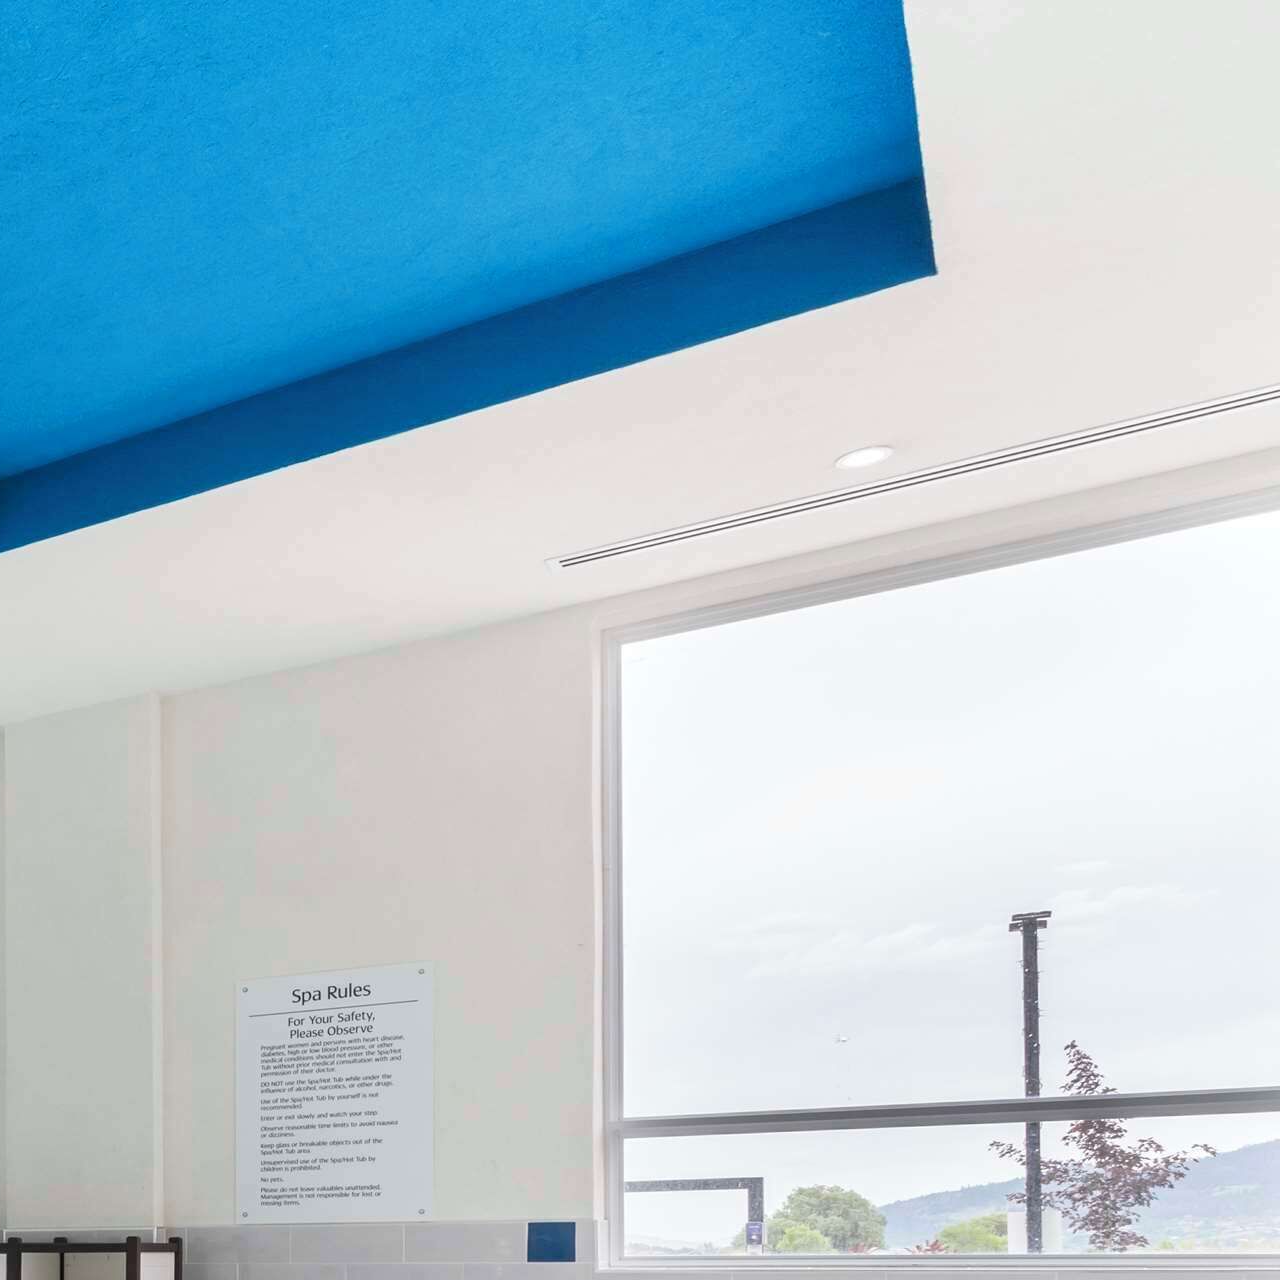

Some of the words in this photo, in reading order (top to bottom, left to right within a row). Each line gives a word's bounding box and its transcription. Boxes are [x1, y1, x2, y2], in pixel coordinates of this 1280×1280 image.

[291, 988, 322, 1006] Spa
[327, 982, 372, 1000] Rules
[287, 1017, 305, 1027] For
[309, 1015, 335, 1025] Your
[337, 1010, 376, 1024] Safety,
[289, 1028, 324, 1039] Please
[327, 1024, 374, 1037] Observe
